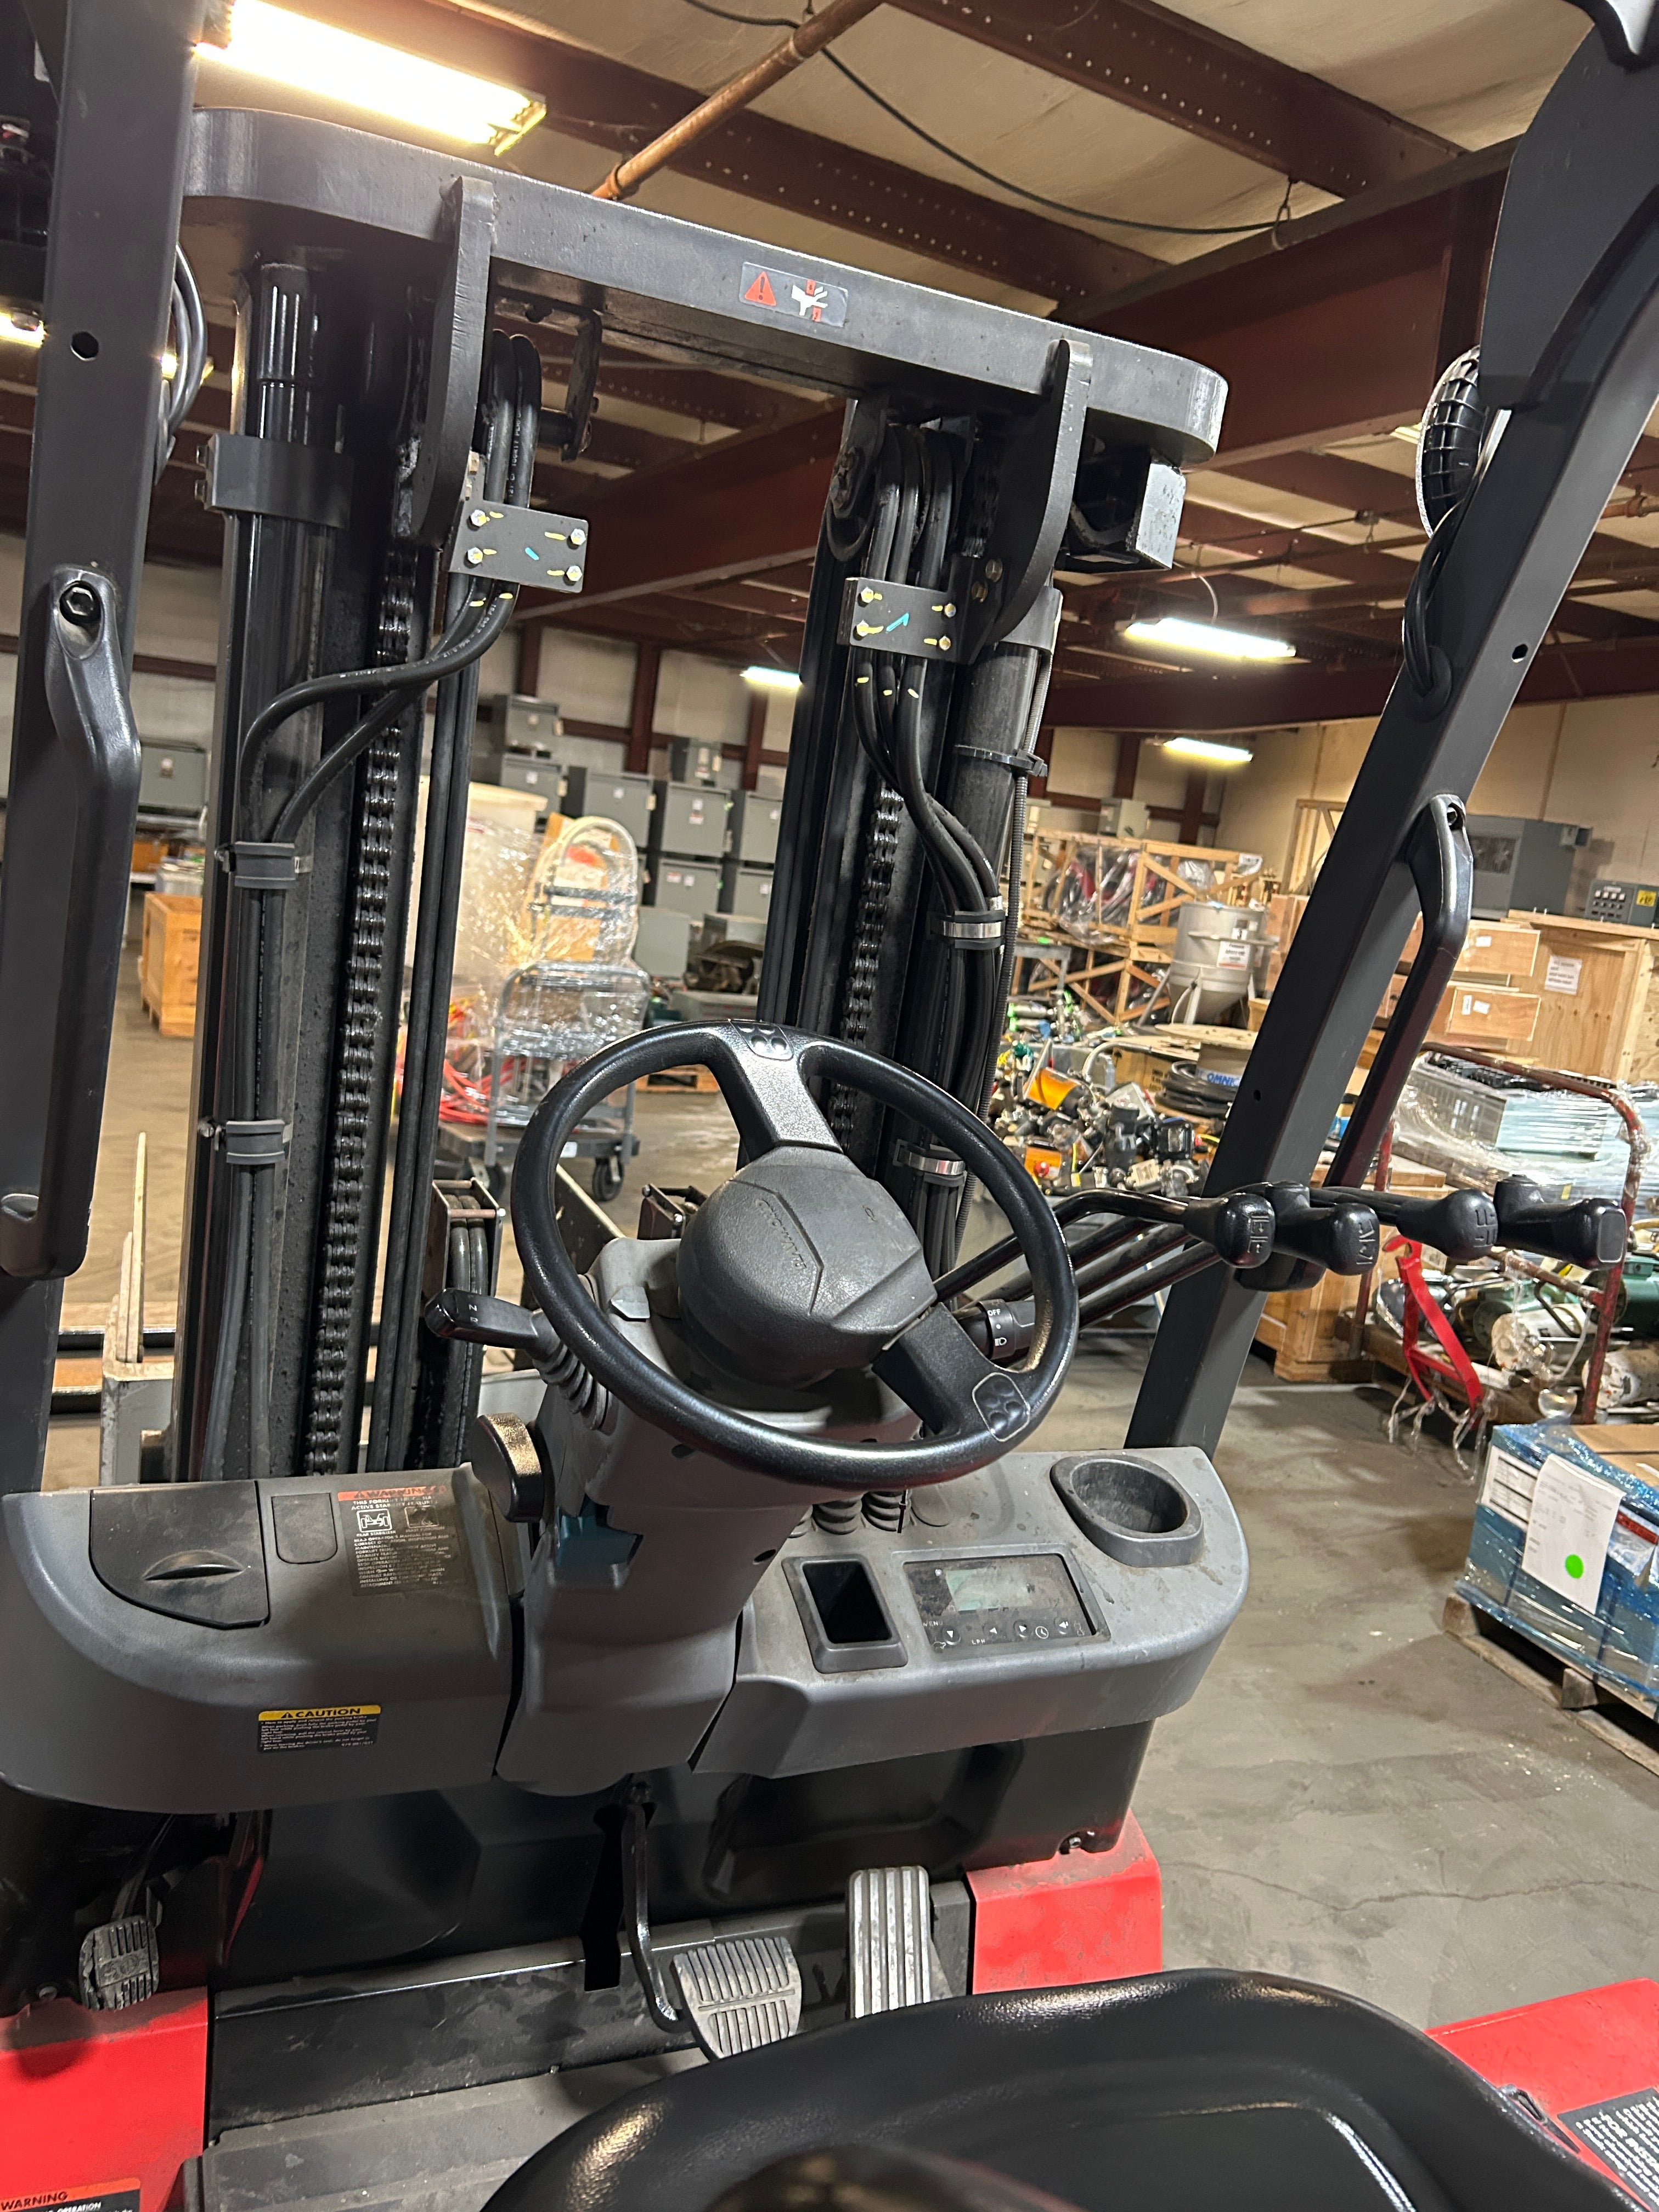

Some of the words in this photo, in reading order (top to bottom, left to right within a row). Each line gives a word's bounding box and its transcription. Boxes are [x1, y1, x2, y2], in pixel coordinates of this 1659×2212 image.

[987, 1308, 1001, 1317] OFF
[295, 1708, 360, 1718] CAUTION
[1, 2191, 68, 2211] WARNING
